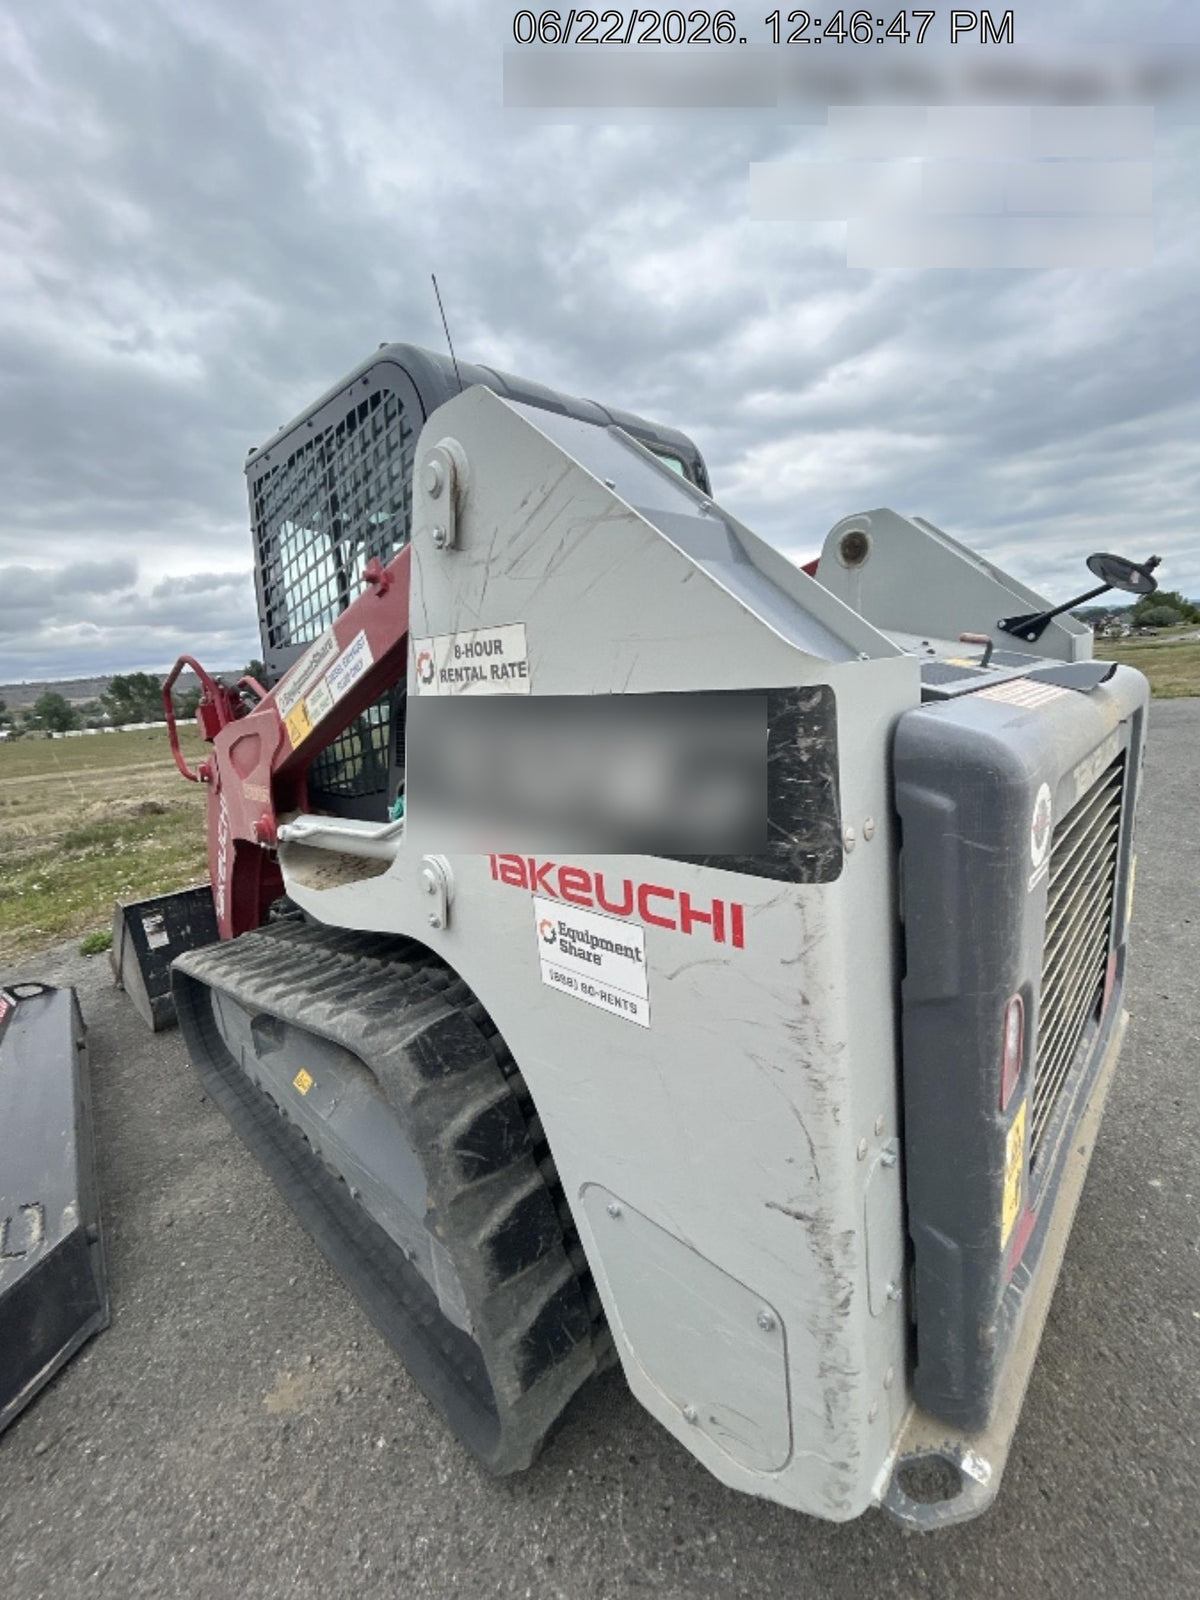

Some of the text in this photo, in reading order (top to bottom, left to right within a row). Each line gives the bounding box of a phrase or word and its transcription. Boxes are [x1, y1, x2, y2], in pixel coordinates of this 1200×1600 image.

[454, 639, 504, 660] 8-HOUR
[440, 660, 528, 684] RENTAL RATE
[557, 920, 643, 964] Equipment
[559, 938, 602, 966] Share
